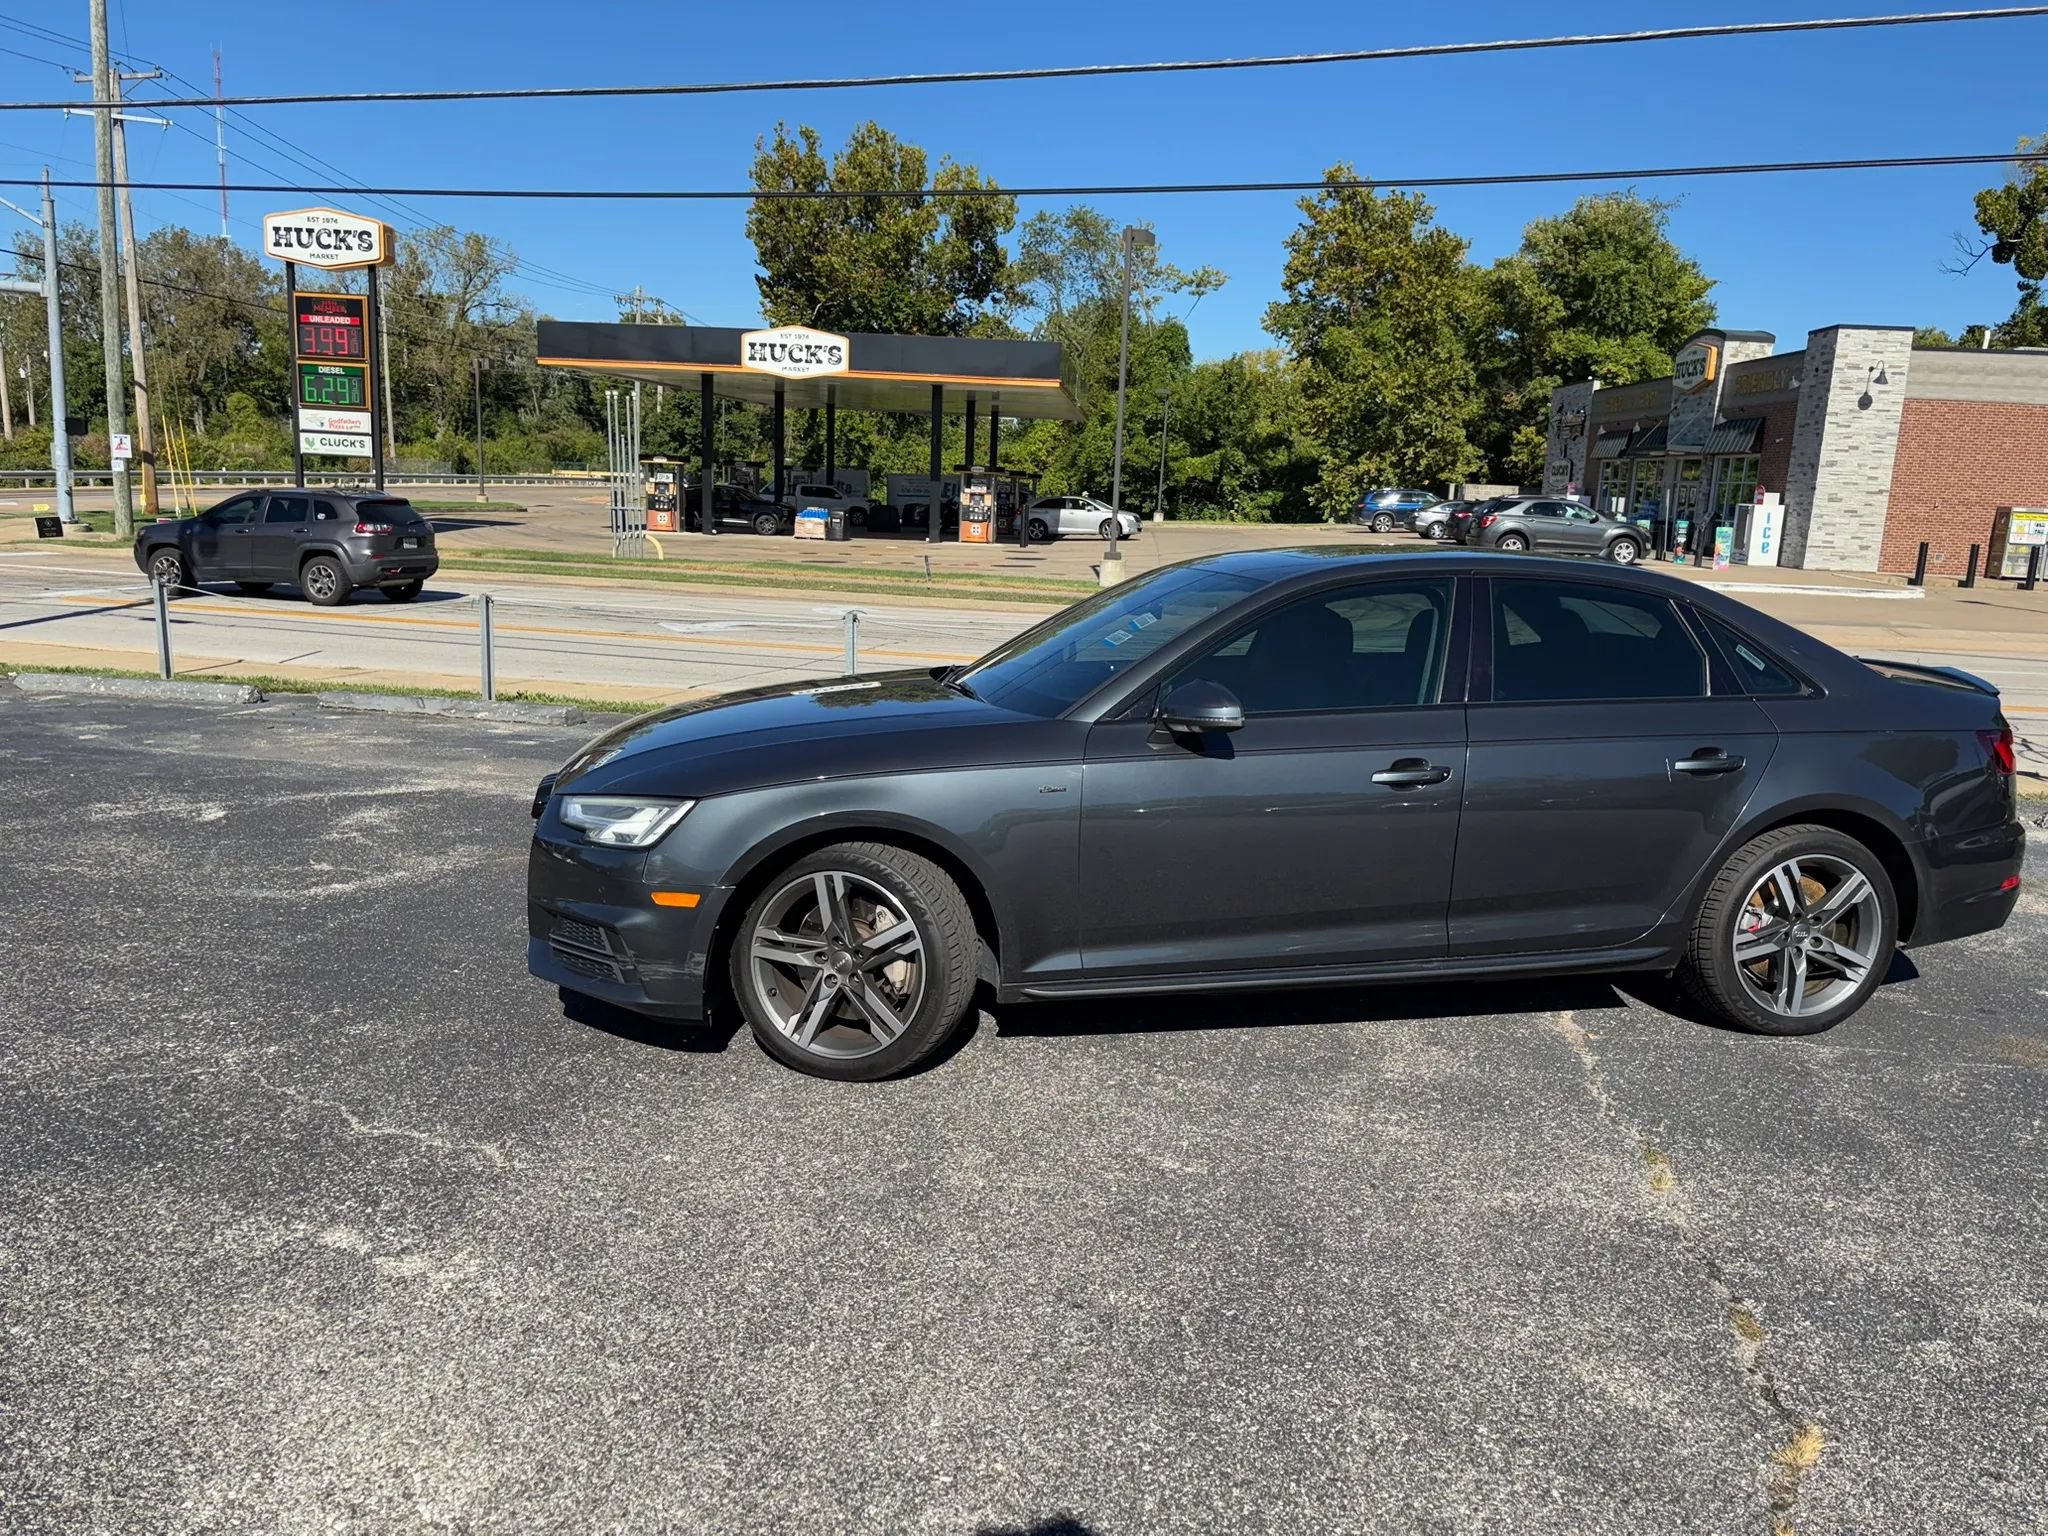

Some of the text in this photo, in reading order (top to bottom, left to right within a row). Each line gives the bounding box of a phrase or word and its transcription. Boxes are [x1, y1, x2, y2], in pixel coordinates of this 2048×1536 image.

[272, 226, 374, 252] HUCK'S
[309, 315, 351, 325] UNLEADED
[748, 342, 842, 365] HUCK'S
[318, 366, 345, 375] DIESEL
[1674, 357, 1706, 380] HUCK'S
[304, 375, 350, 404] 6.29
[320, 437, 366, 449] CLUCK'S
